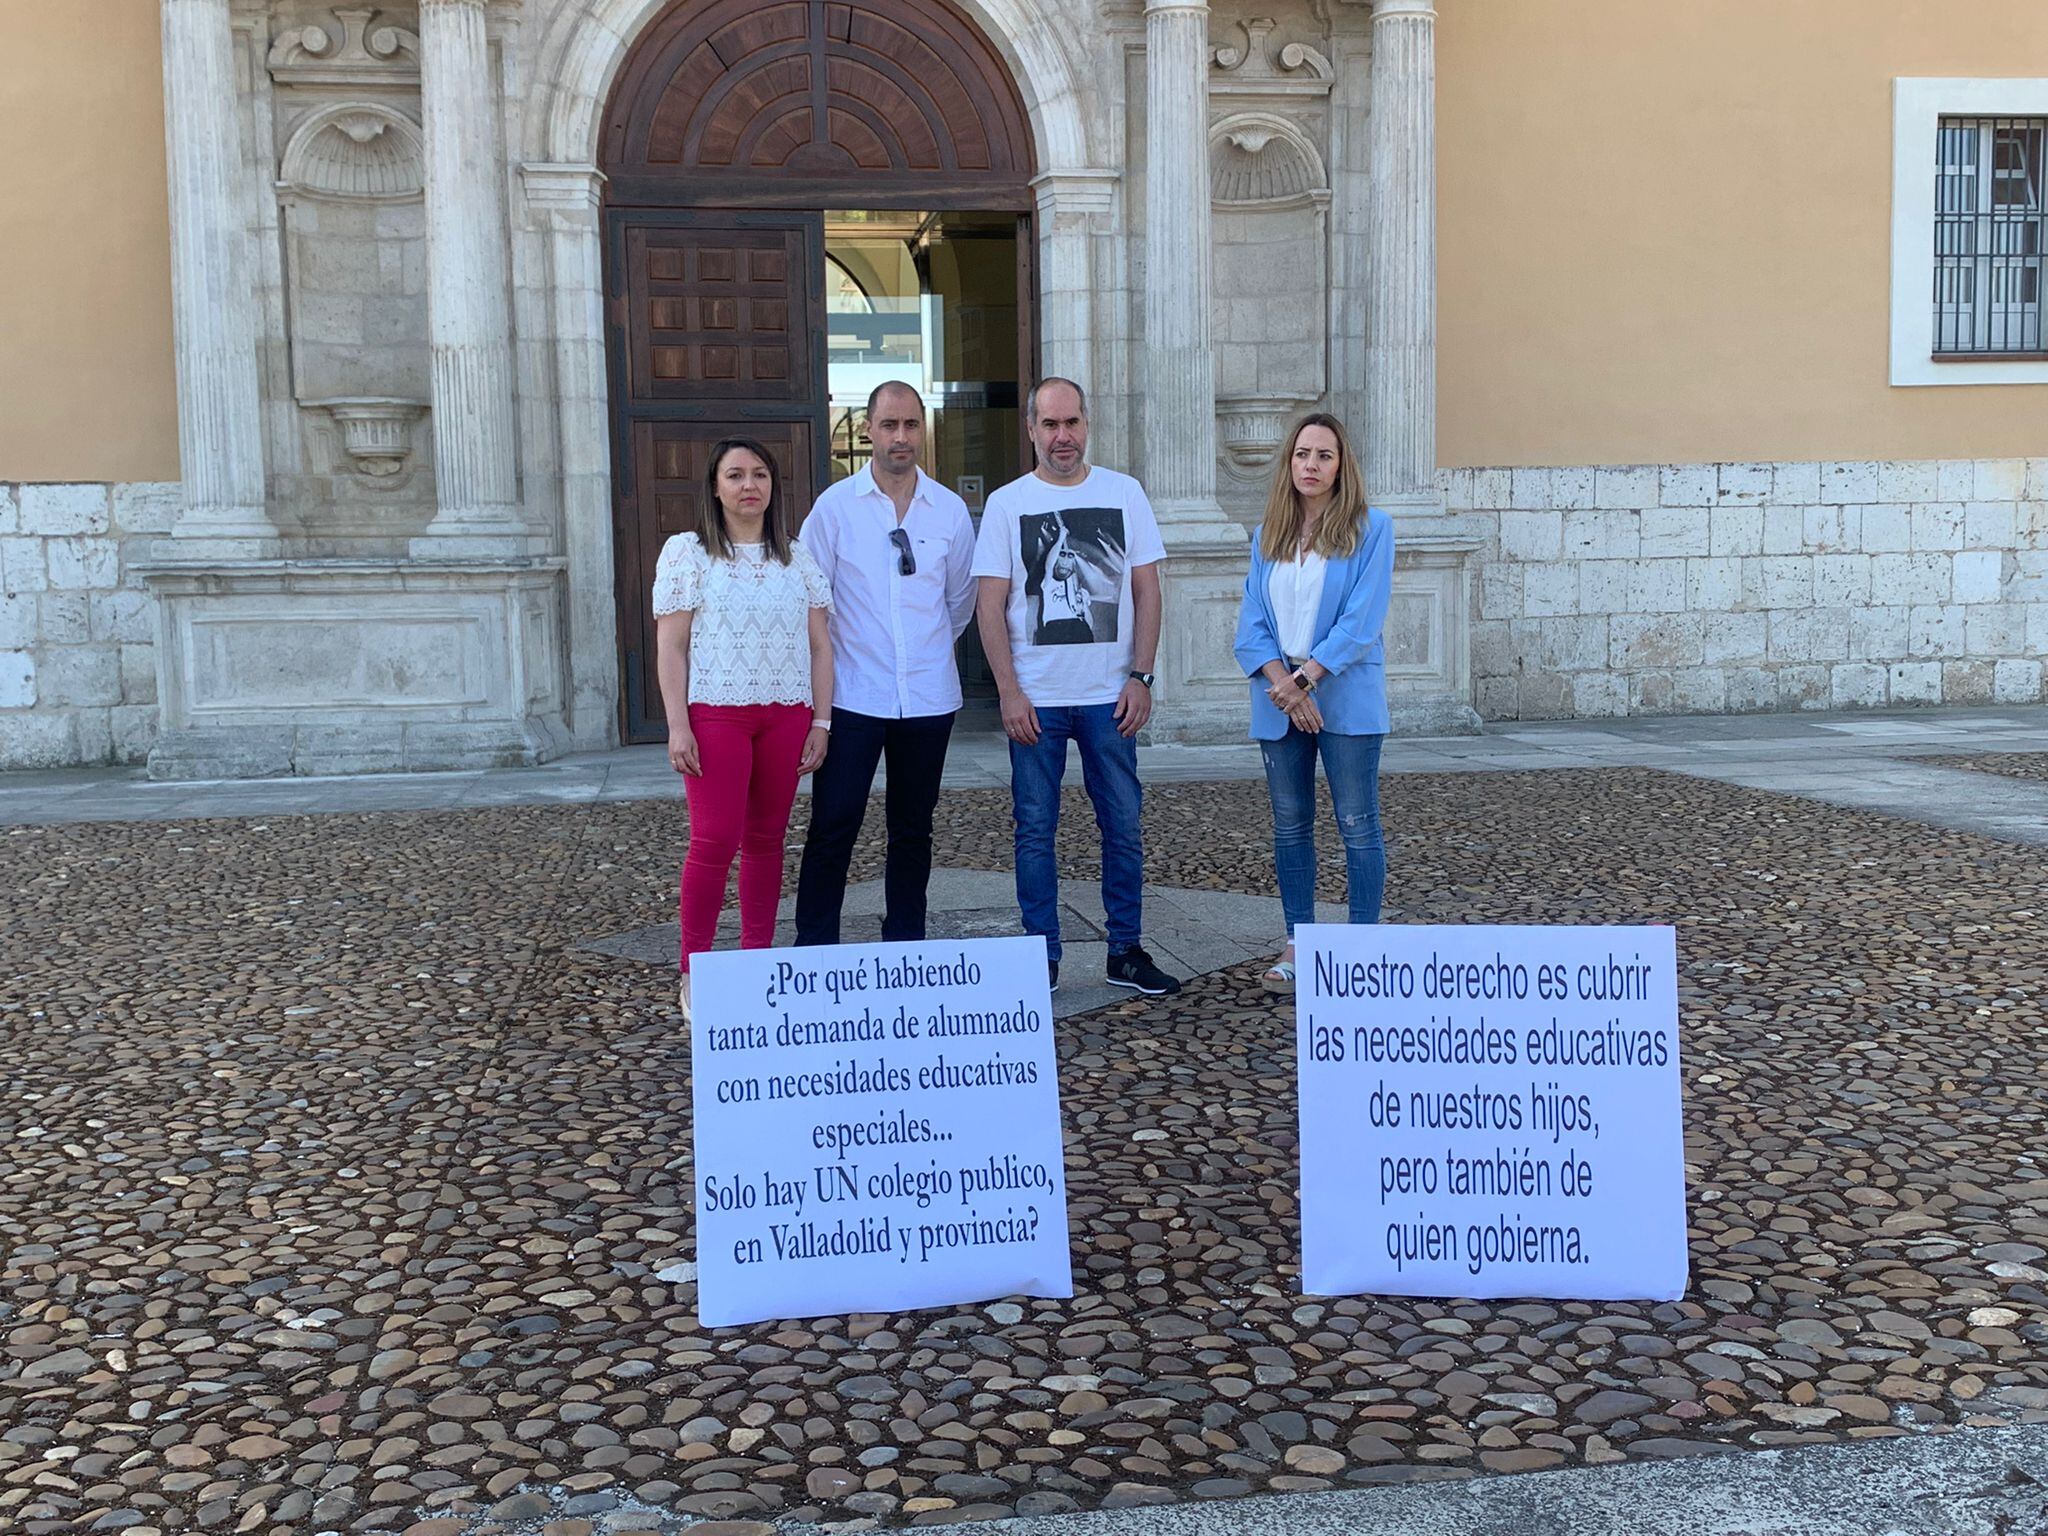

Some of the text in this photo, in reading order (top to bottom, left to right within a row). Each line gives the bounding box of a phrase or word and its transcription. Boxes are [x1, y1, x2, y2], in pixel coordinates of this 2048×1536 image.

[766, 952, 981, 1008] ¿Por qué habiendo
[1315, 950, 1652, 1001] Nuestro derecho es cubrir
[707, 999, 1040, 1052] tanta demanda de alumnado
[1309, 1013, 1668, 1067] las necesidades educativas
[717, 1051, 1038, 1104] con necesidades educativas
[812, 1108, 953, 1161] especiales...
[1369, 1079, 1599, 1144] de nuestros hijos,
[704, 1153, 1054, 1217] Solo hay UN colegio publico,
[1380, 1146, 1593, 1206] pero también de
[733, 1201, 1039, 1265] en Valladolid y provincia?
[1386, 1211, 1590, 1276] quien gobierna.
